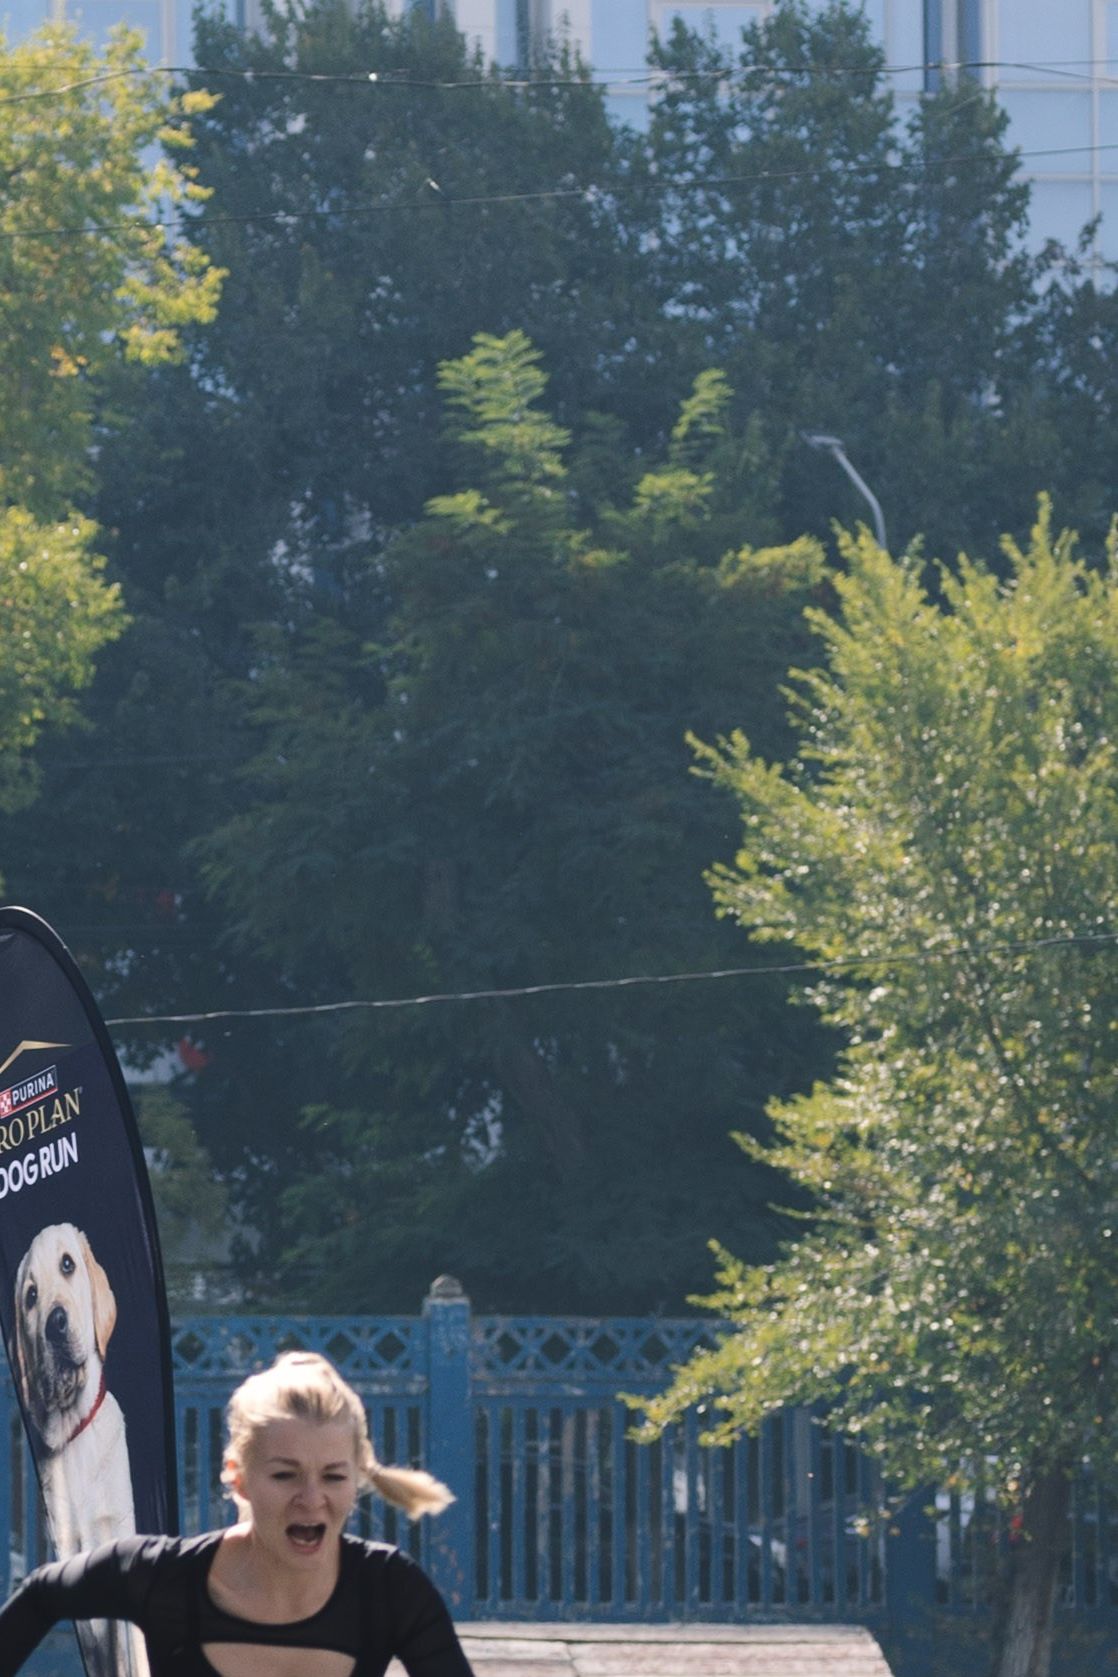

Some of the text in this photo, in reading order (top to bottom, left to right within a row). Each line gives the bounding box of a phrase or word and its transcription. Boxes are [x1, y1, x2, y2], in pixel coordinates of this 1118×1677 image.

[11, 1072, 55, 1106] PURINA
[25, 1087, 81, 1140] PLAN
[38, 1131, 79, 1179] RUN
